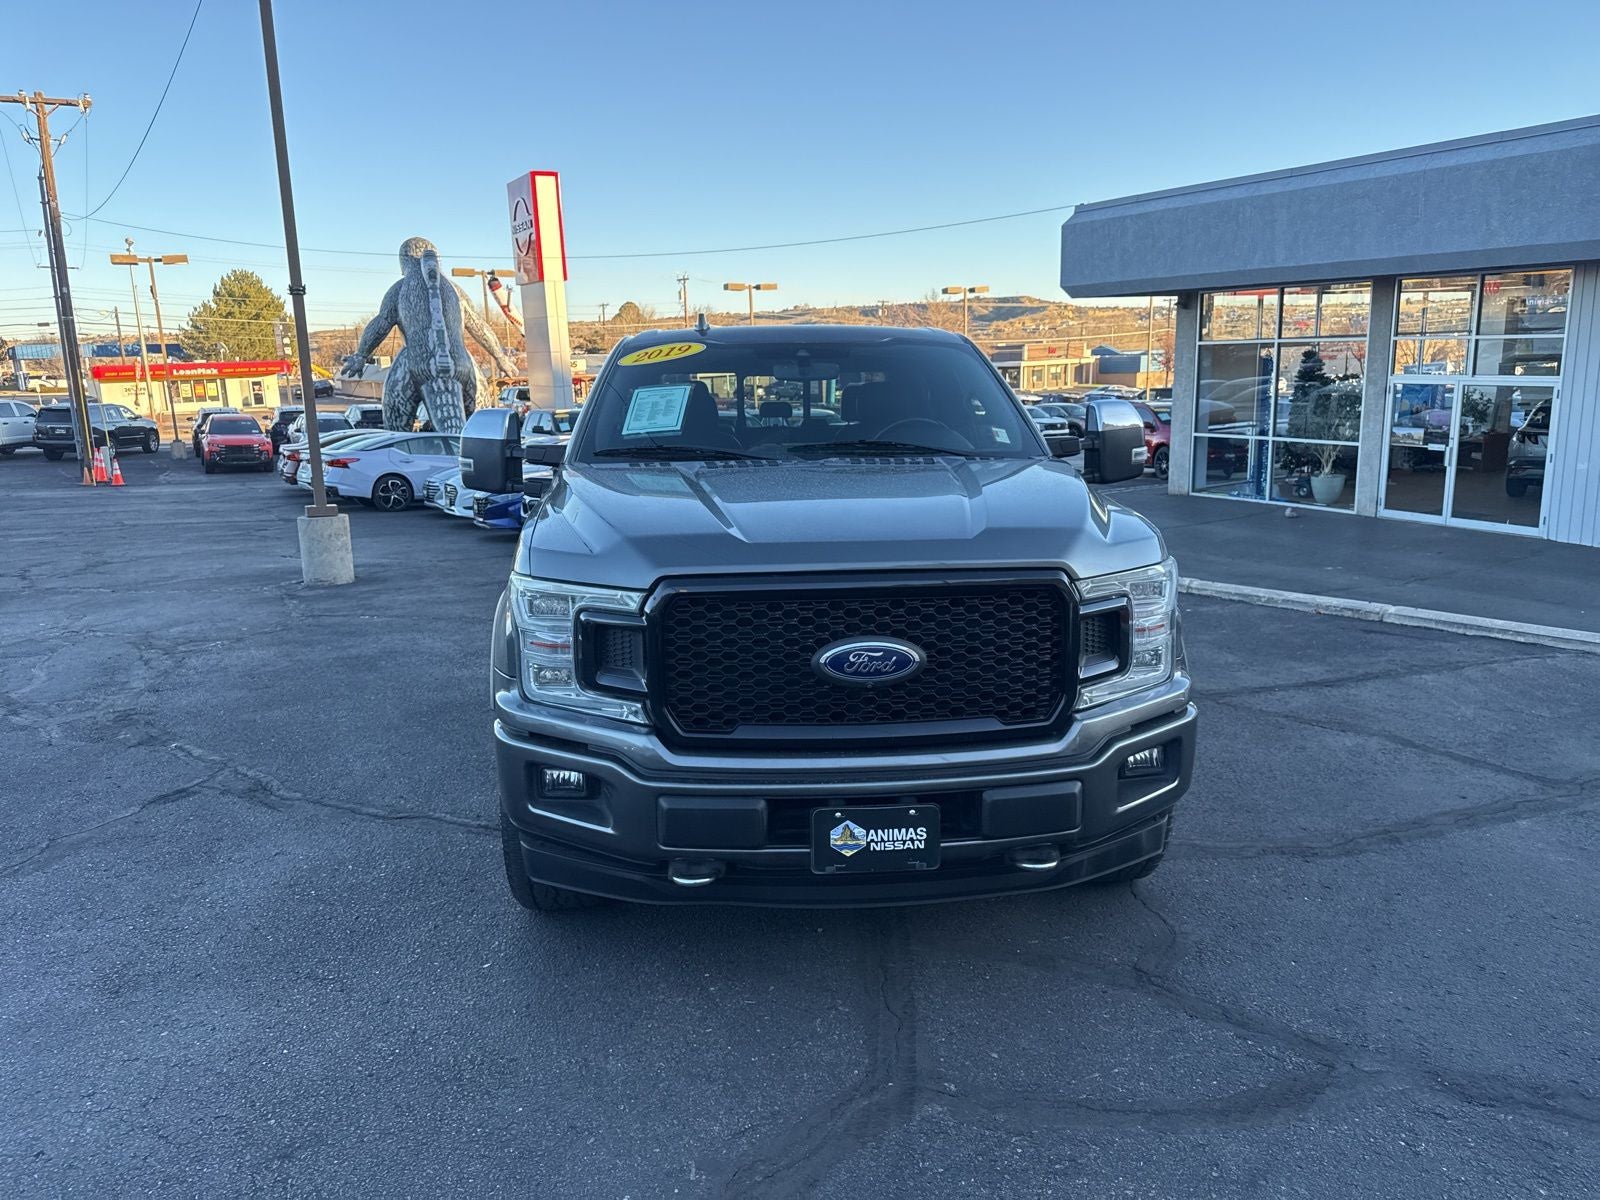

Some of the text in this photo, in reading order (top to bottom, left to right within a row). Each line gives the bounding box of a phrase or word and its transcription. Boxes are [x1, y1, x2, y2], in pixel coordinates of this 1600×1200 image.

[631, 344, 692, 364] 2019
[172, 367, 219, 376] LoanMax
[843, 651, 897, 673] Ford
[866, 827, 927, 842] ANIMAS
[870, 840, 925, 851] NISSAN
